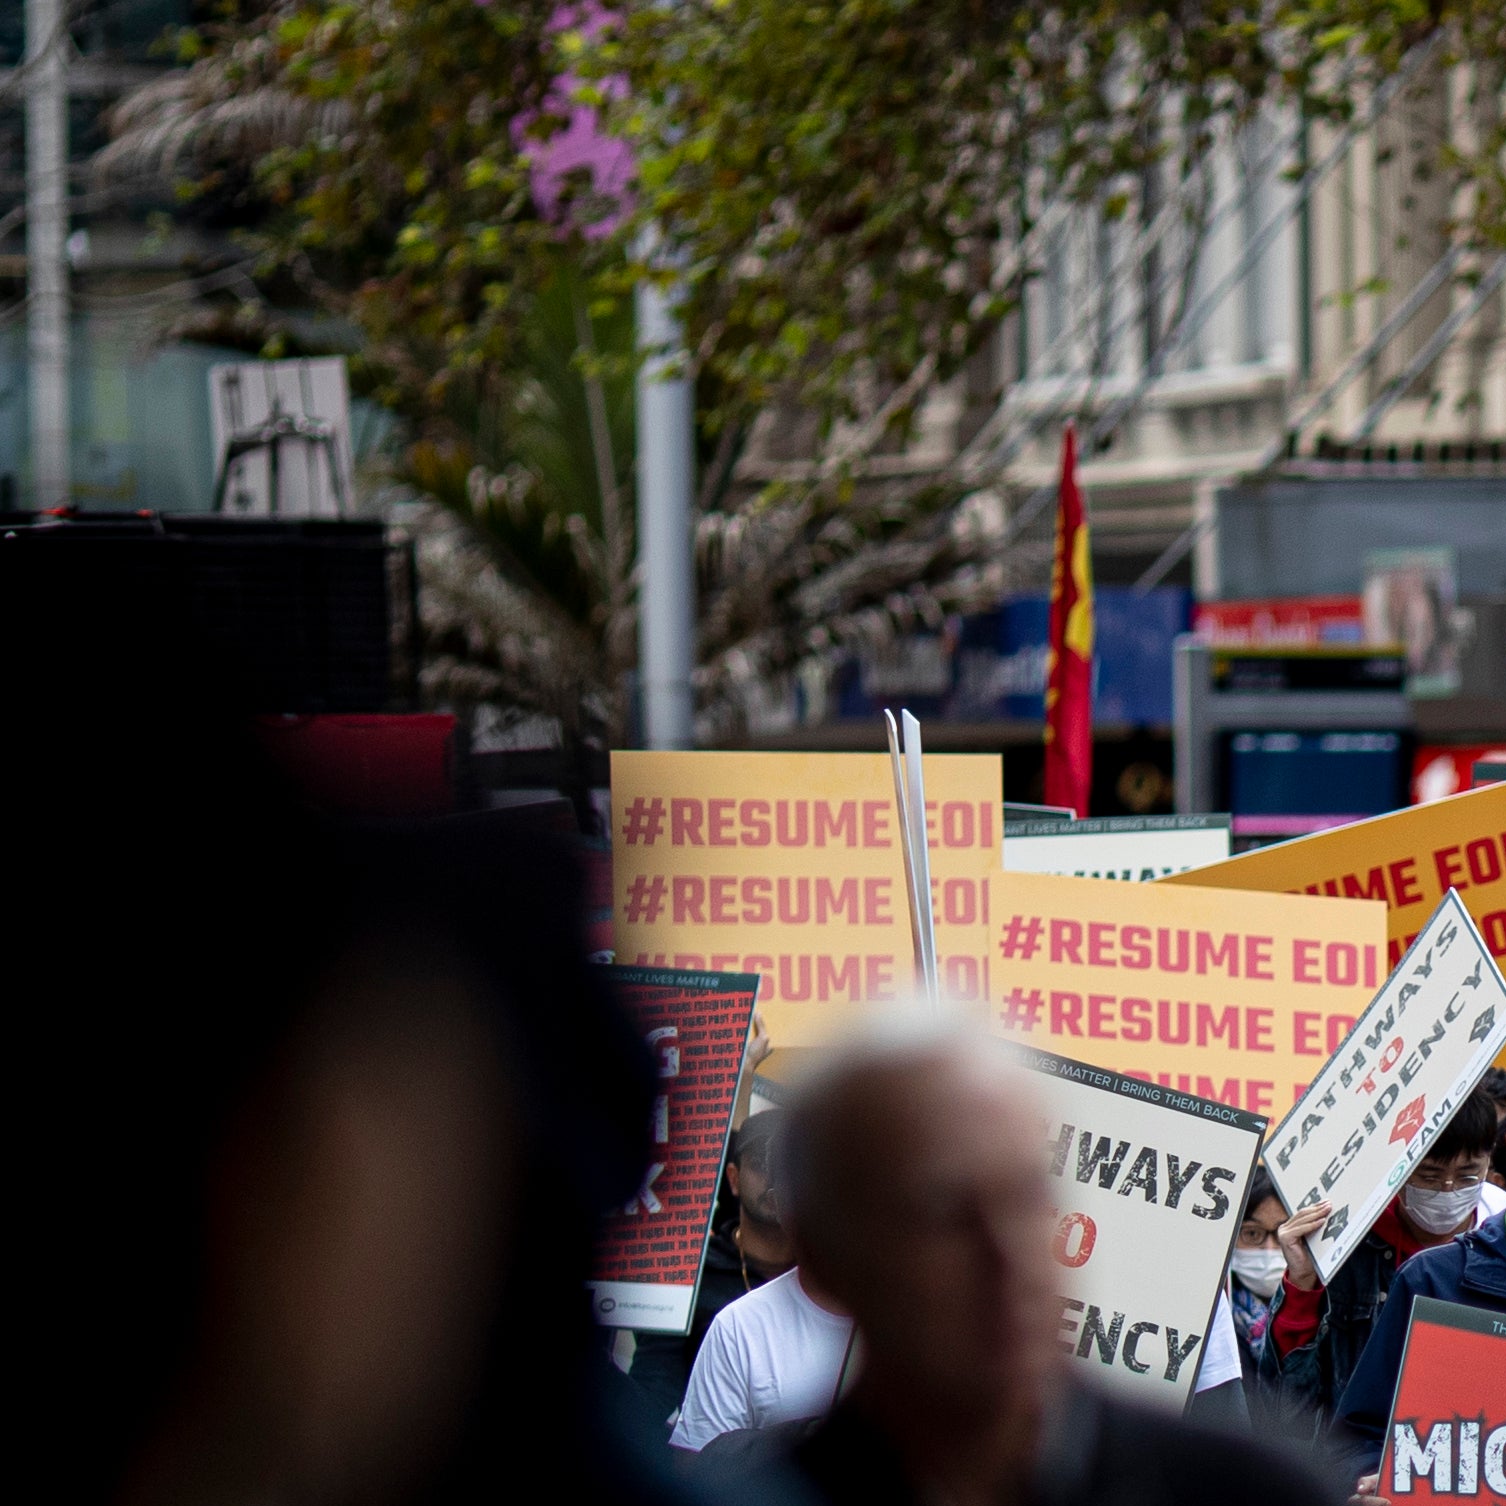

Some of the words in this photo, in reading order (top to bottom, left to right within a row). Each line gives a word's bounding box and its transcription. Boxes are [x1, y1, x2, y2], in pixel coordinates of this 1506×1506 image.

[623, 797, 892, 848] #RESUME
[624, 875, 894, 925] #RESUME
[999, 914, 1275, 981] #RESUME
[1292, 940, 1379, 989] EOI
[999, 987, 1275, 1053] #RESUME
[1292, 1008, 1358, 1058] EO
[1275, 919, 1459, 1172] PATHWAYS
[1060, 1063, 1111, 1089] MATTER
[1121, 1081, 1161, 1102] BRING
[1165, 1092, 1200, 1113] THEM
[1203, 1103, 1239, 1124] BACK
[1355, 1036, 1405, 1098] TO
[1407, 1097, 1454, 1163] FAM
[1047, 1122, 1237, 1221] HWAYS
